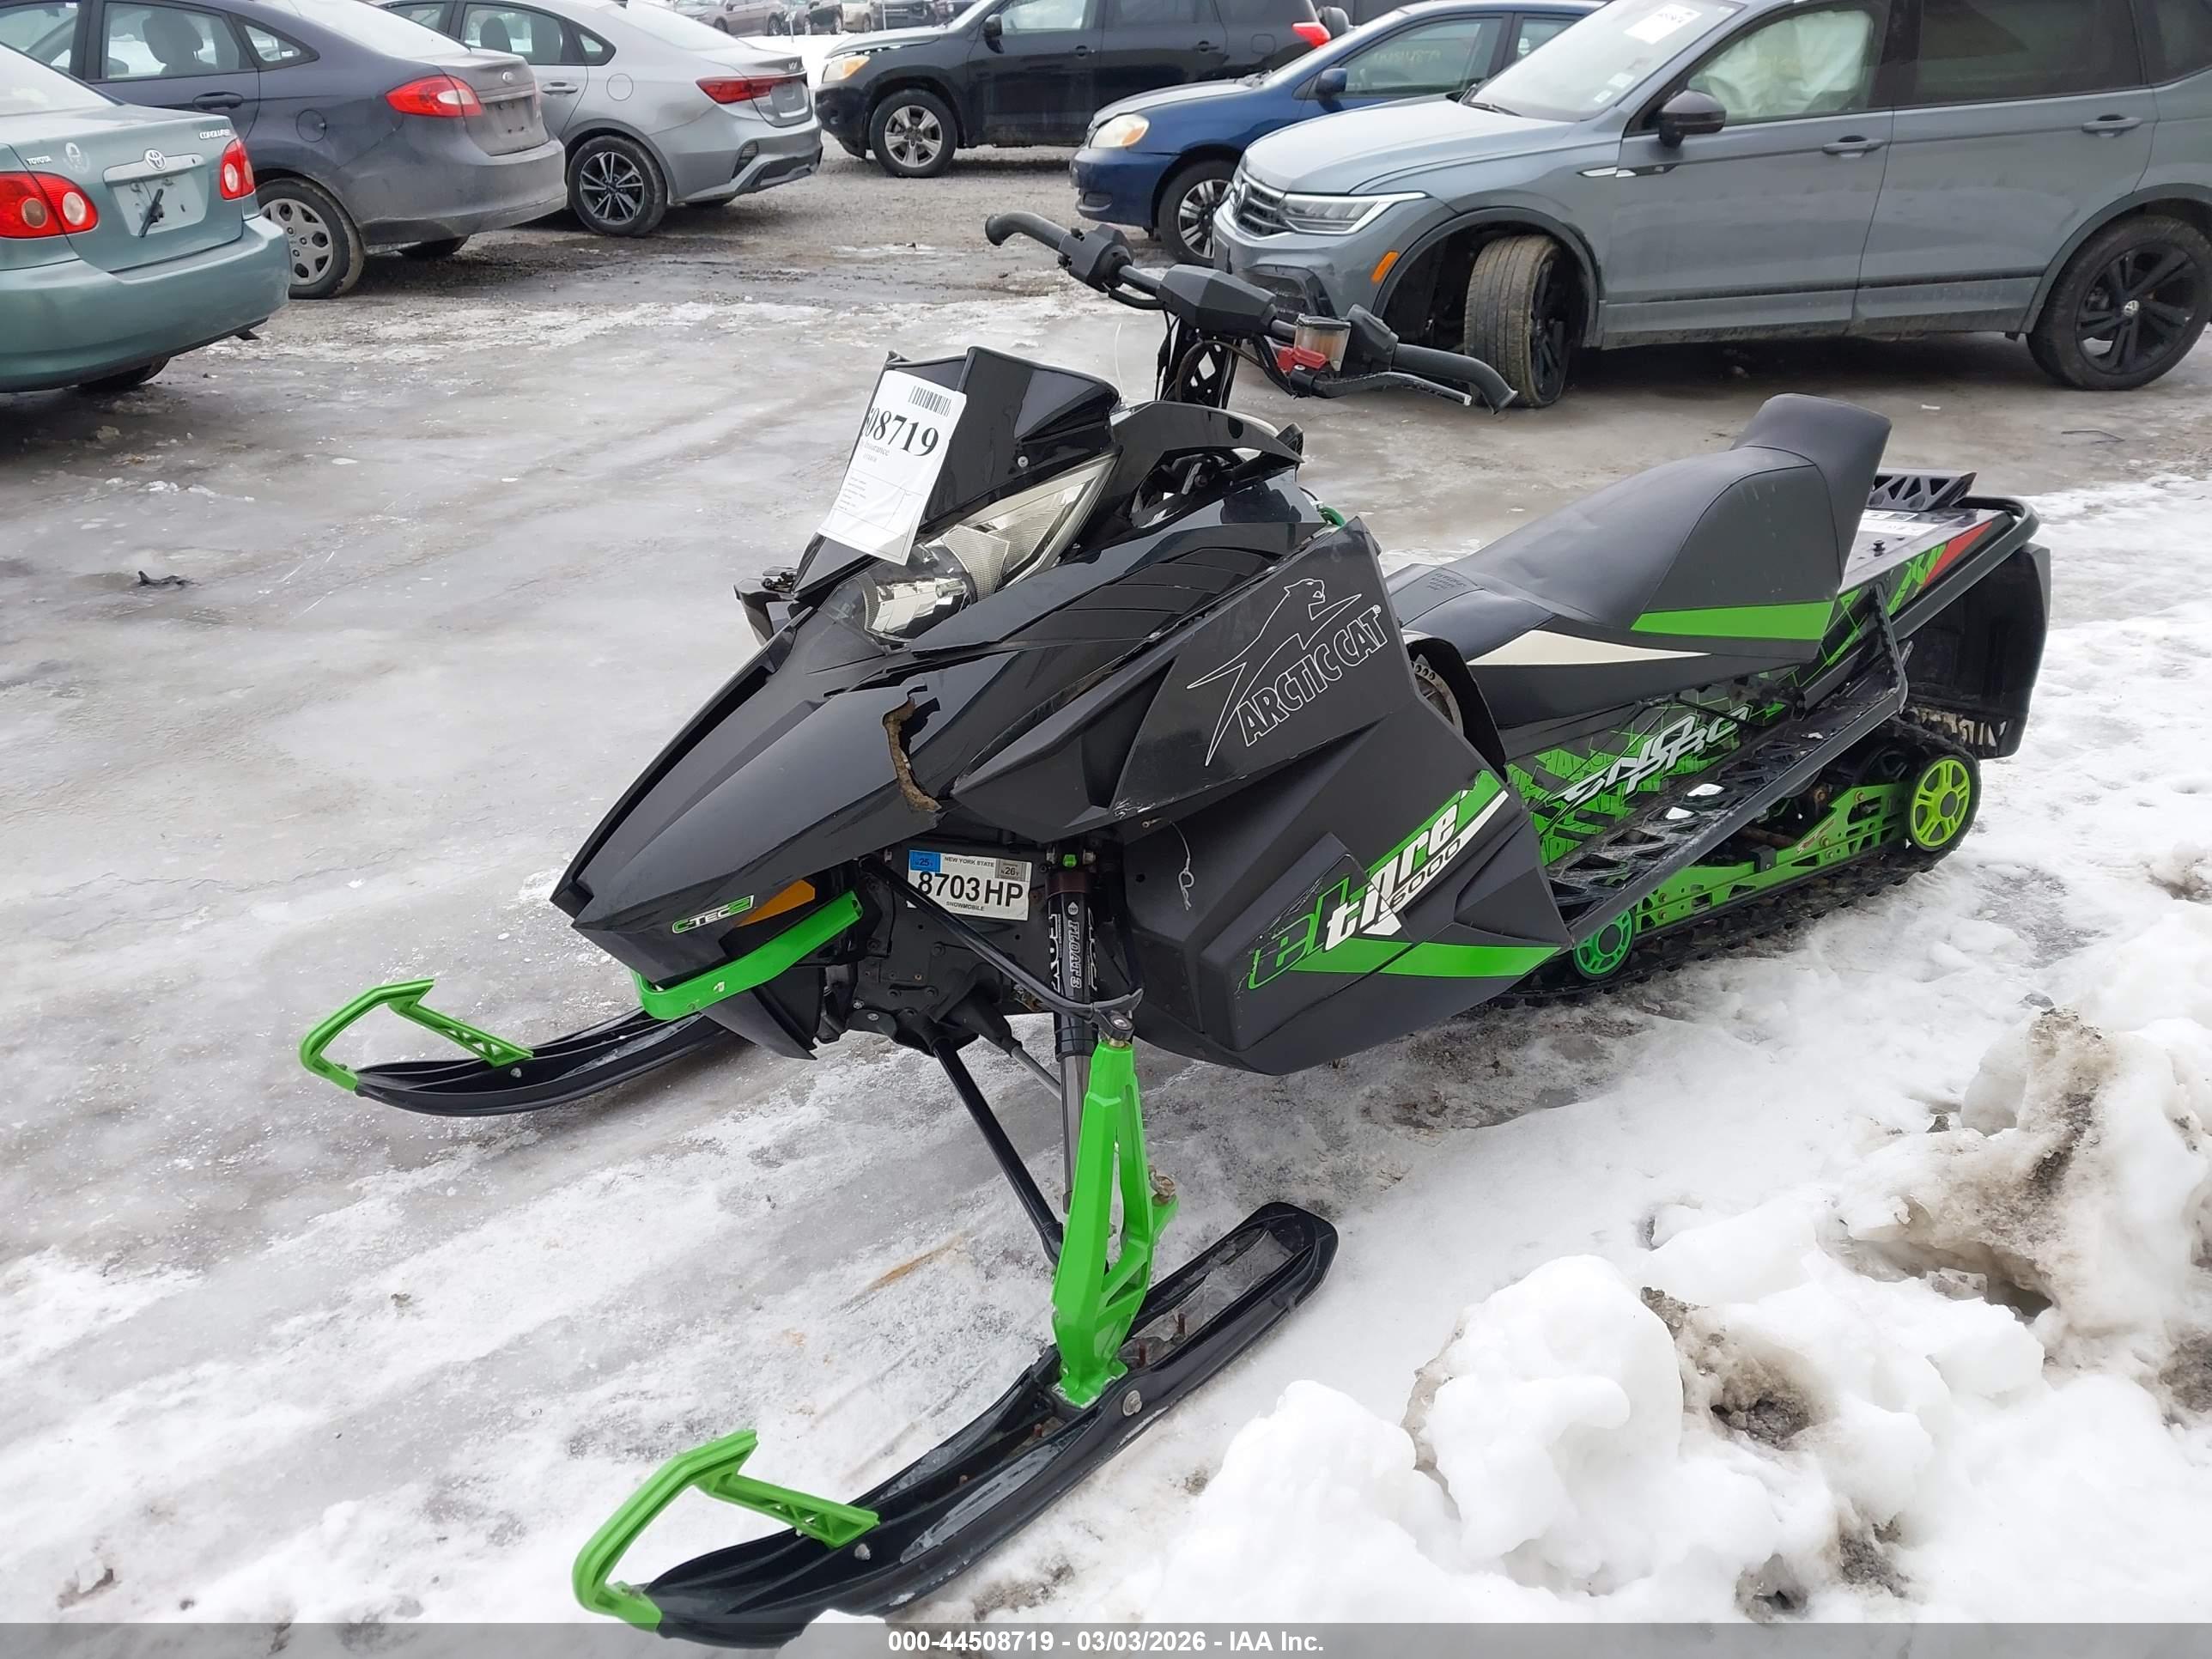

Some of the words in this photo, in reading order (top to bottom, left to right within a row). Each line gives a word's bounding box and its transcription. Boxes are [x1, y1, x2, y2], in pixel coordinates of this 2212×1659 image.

[26, 155, 52, 166] TOYOTA
[1237, 654, 1343, 747] ARCTIC
[1325, 804, 1459, 951] tigre
[1389, 838, 1462, 908] 6000
[945, 901, 985, 911] SNOWMOBILE
[1067, 919, 1083, 977] FLOAT
[1070, 975, 1083, 989] 3
